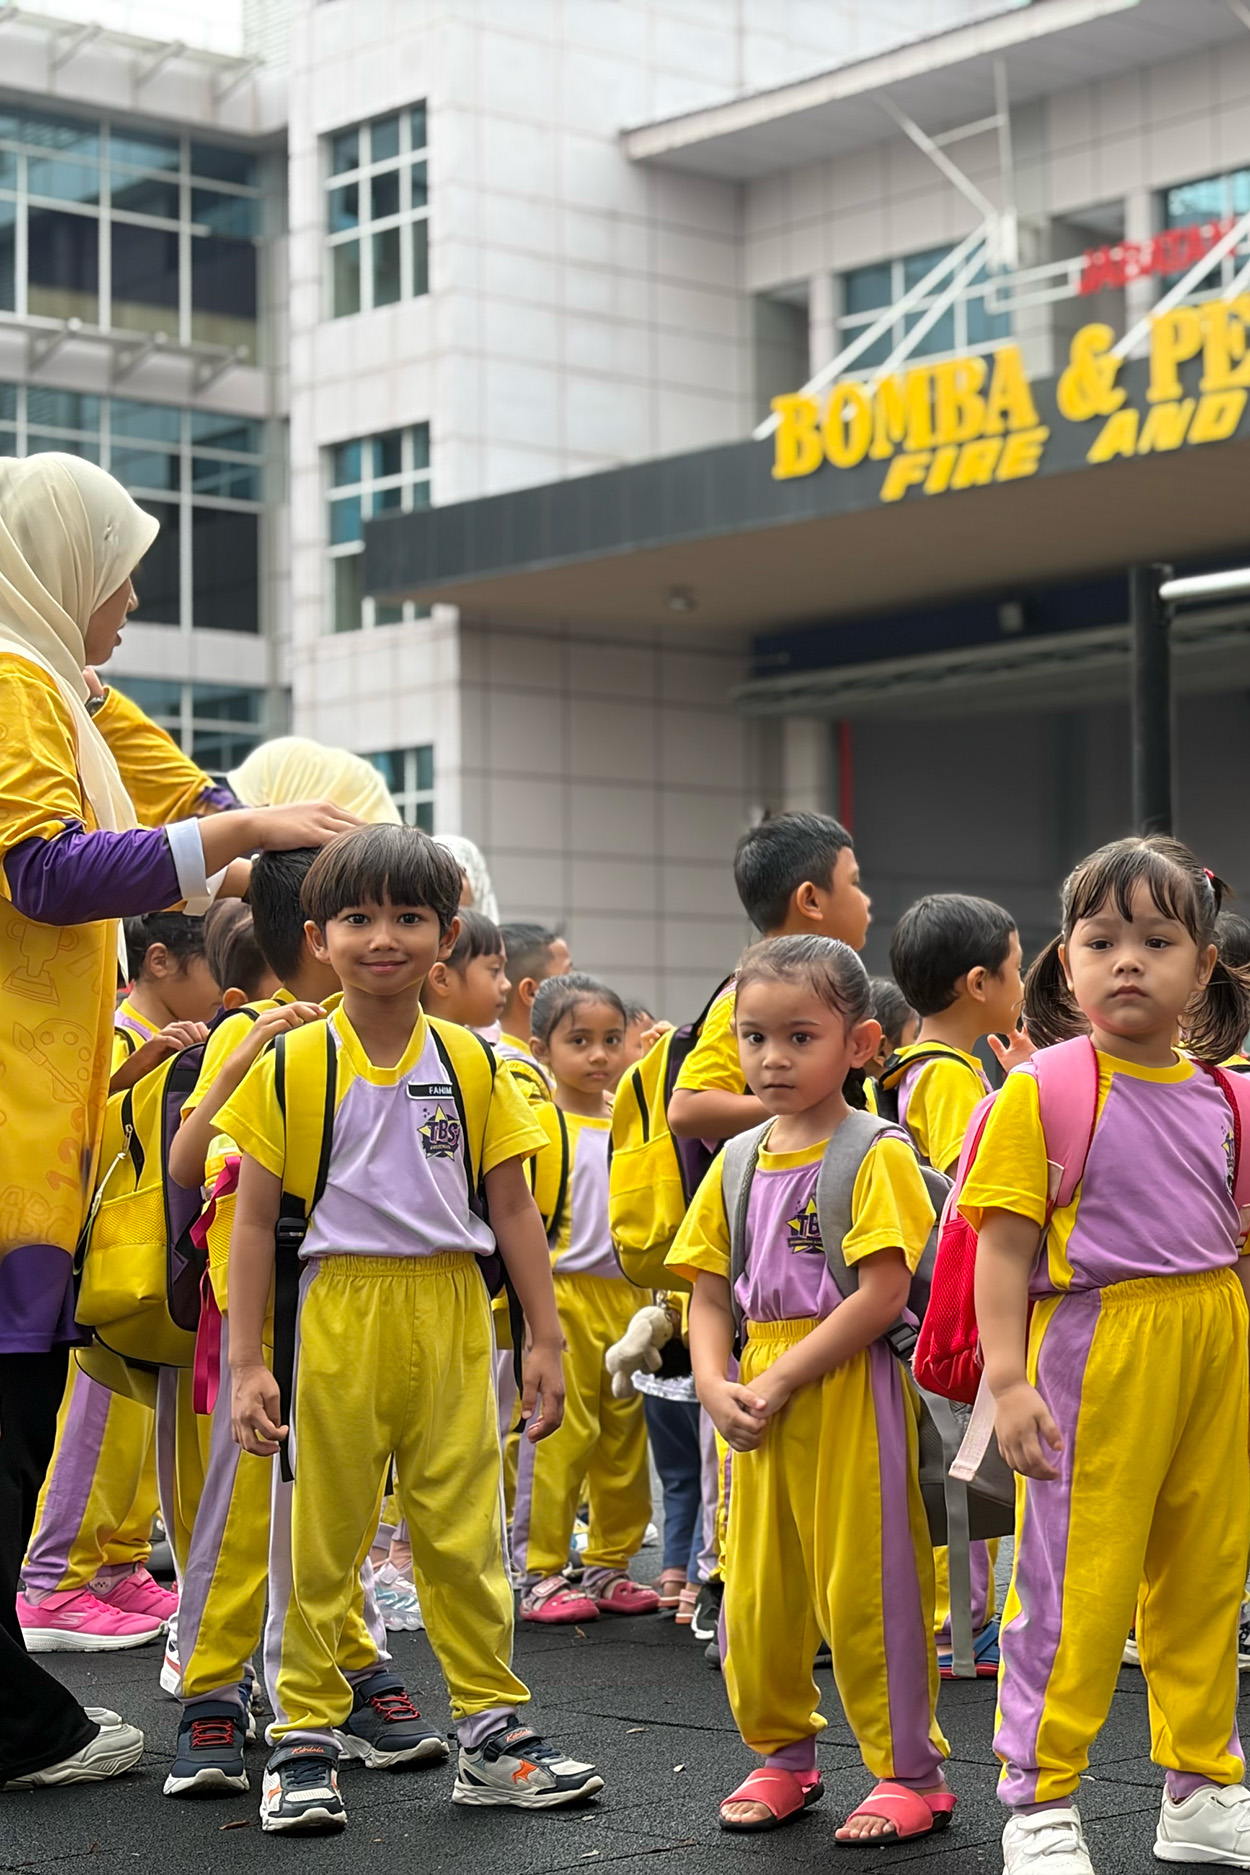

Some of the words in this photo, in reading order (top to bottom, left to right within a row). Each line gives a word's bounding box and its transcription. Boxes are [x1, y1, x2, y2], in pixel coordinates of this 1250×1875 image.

[771, 344, 1041, 480] BOMBA
[1056, 323, 1127, 422] &
[879, 425, 1050, 503] FIRE
[1086, 388, 1248, 463] AND
[427, 1119, 460, 1144] TBS
[795, 1212, 821, 1237] TB
